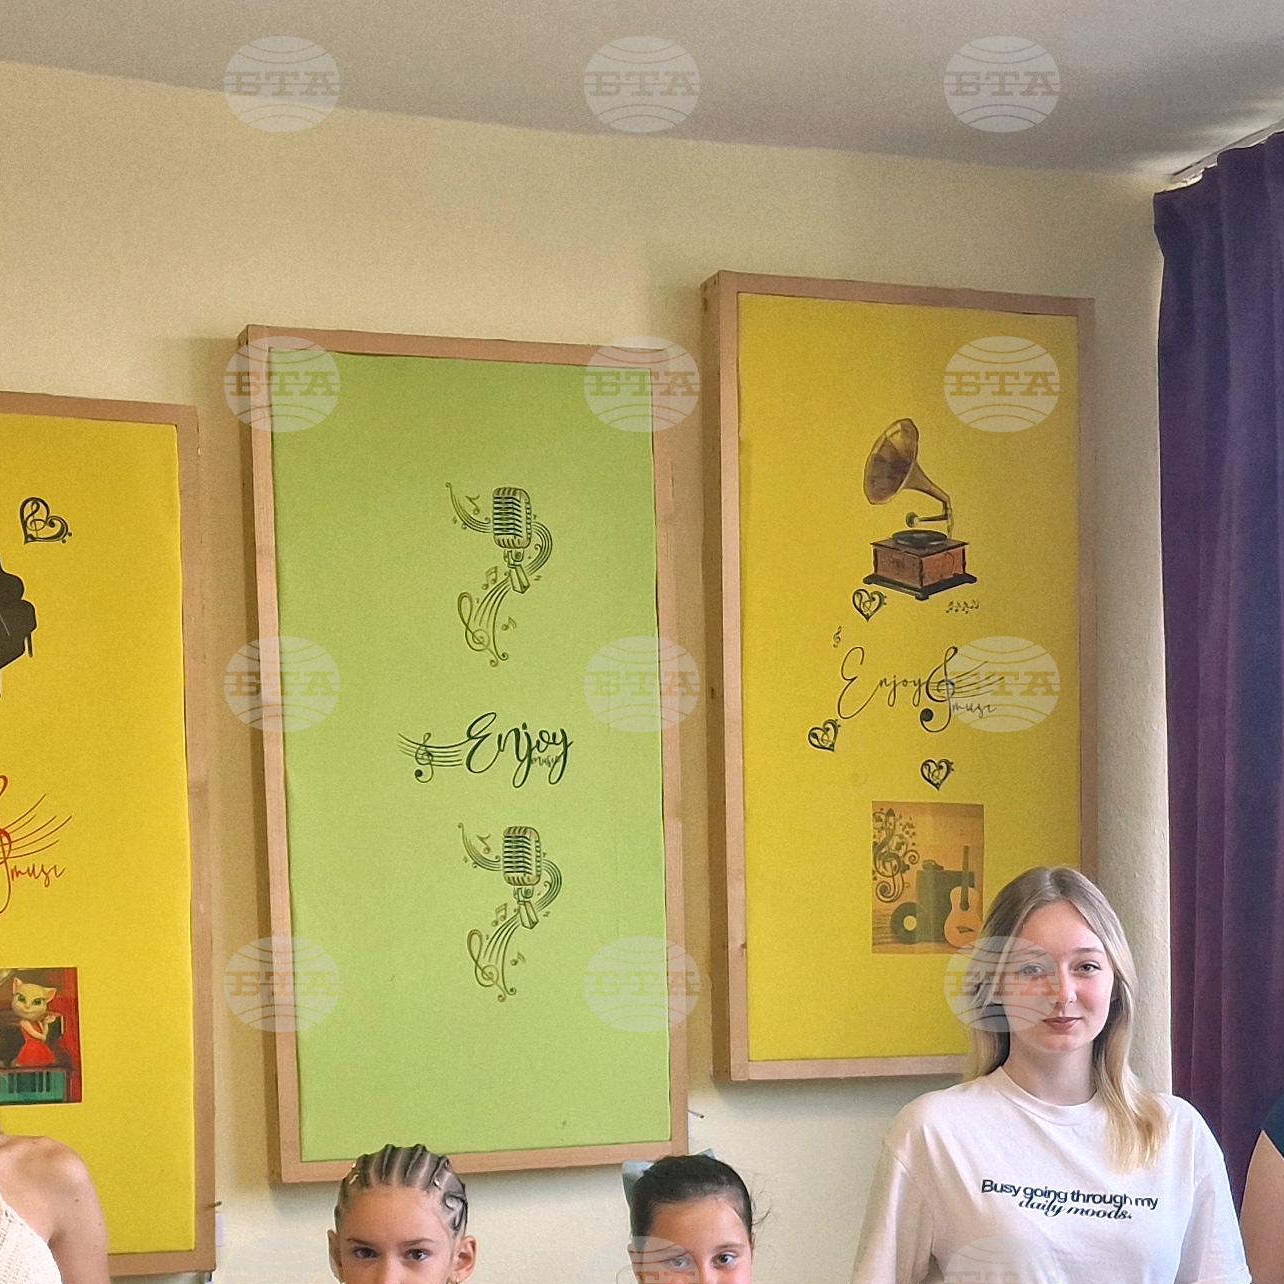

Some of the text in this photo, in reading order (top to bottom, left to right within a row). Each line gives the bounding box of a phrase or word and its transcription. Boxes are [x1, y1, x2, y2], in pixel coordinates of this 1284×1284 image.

[837, 646, 925, 720] Enjoy
[465, 712, 573, 788] Enjoy
[981, 1179, 1158, 1210] Busy going through my
[1018, 1199, 1133, 1220] daily moods.
